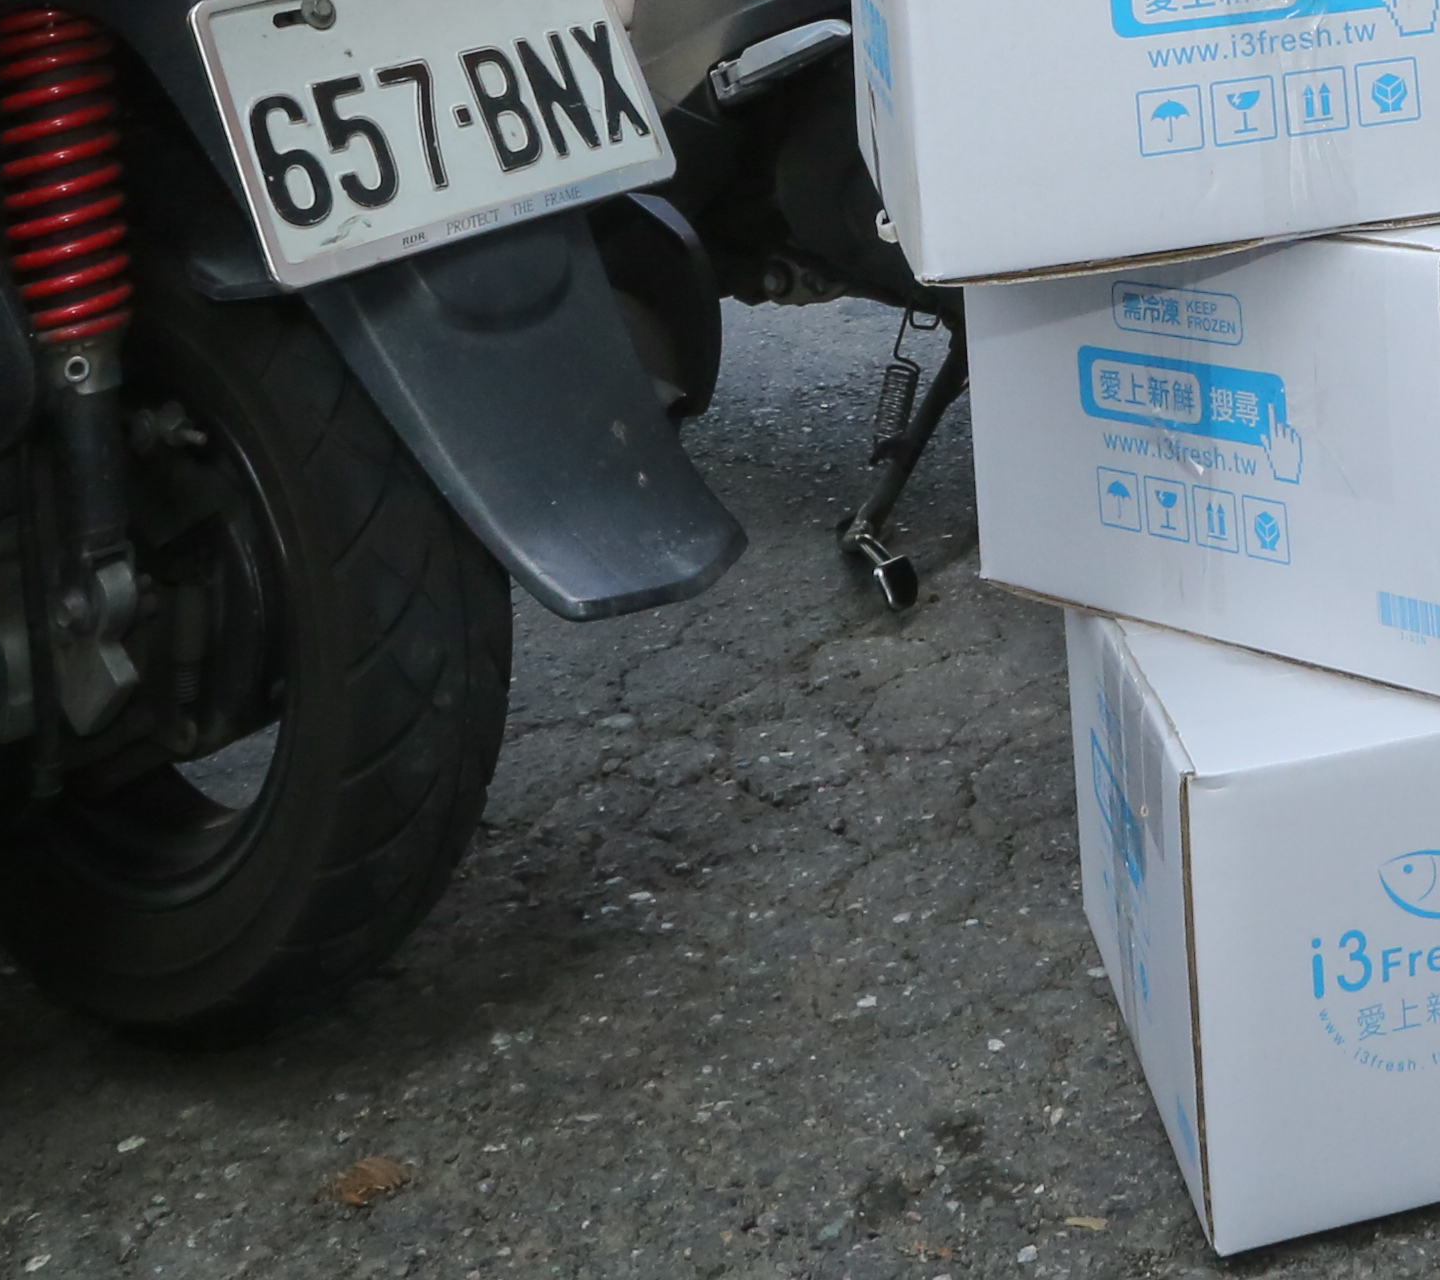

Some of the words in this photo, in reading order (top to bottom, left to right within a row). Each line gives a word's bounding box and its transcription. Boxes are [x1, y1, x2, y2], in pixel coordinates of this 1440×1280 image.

[1148, 22, 1377, 68] www.i3fresh.tw
[248, 21, 651, 228] 657-BNX
[446, 209, 499, 236] PROTECT
[512, 200, 534, 217] THE
[544, 186, 582, 208] FRAME
[1122, 292, 1181, 326] 需冷凍
[1186, 300, 1218, 315] KEEP
[1187, 315, 1237, 335] FROZEN
[1099, 369, 1196, 416] 愛上新鮮
[1209, 386, 1261, 428] 搜尋
[1103, 432, 1258, 476] www.i3fresh.tw
